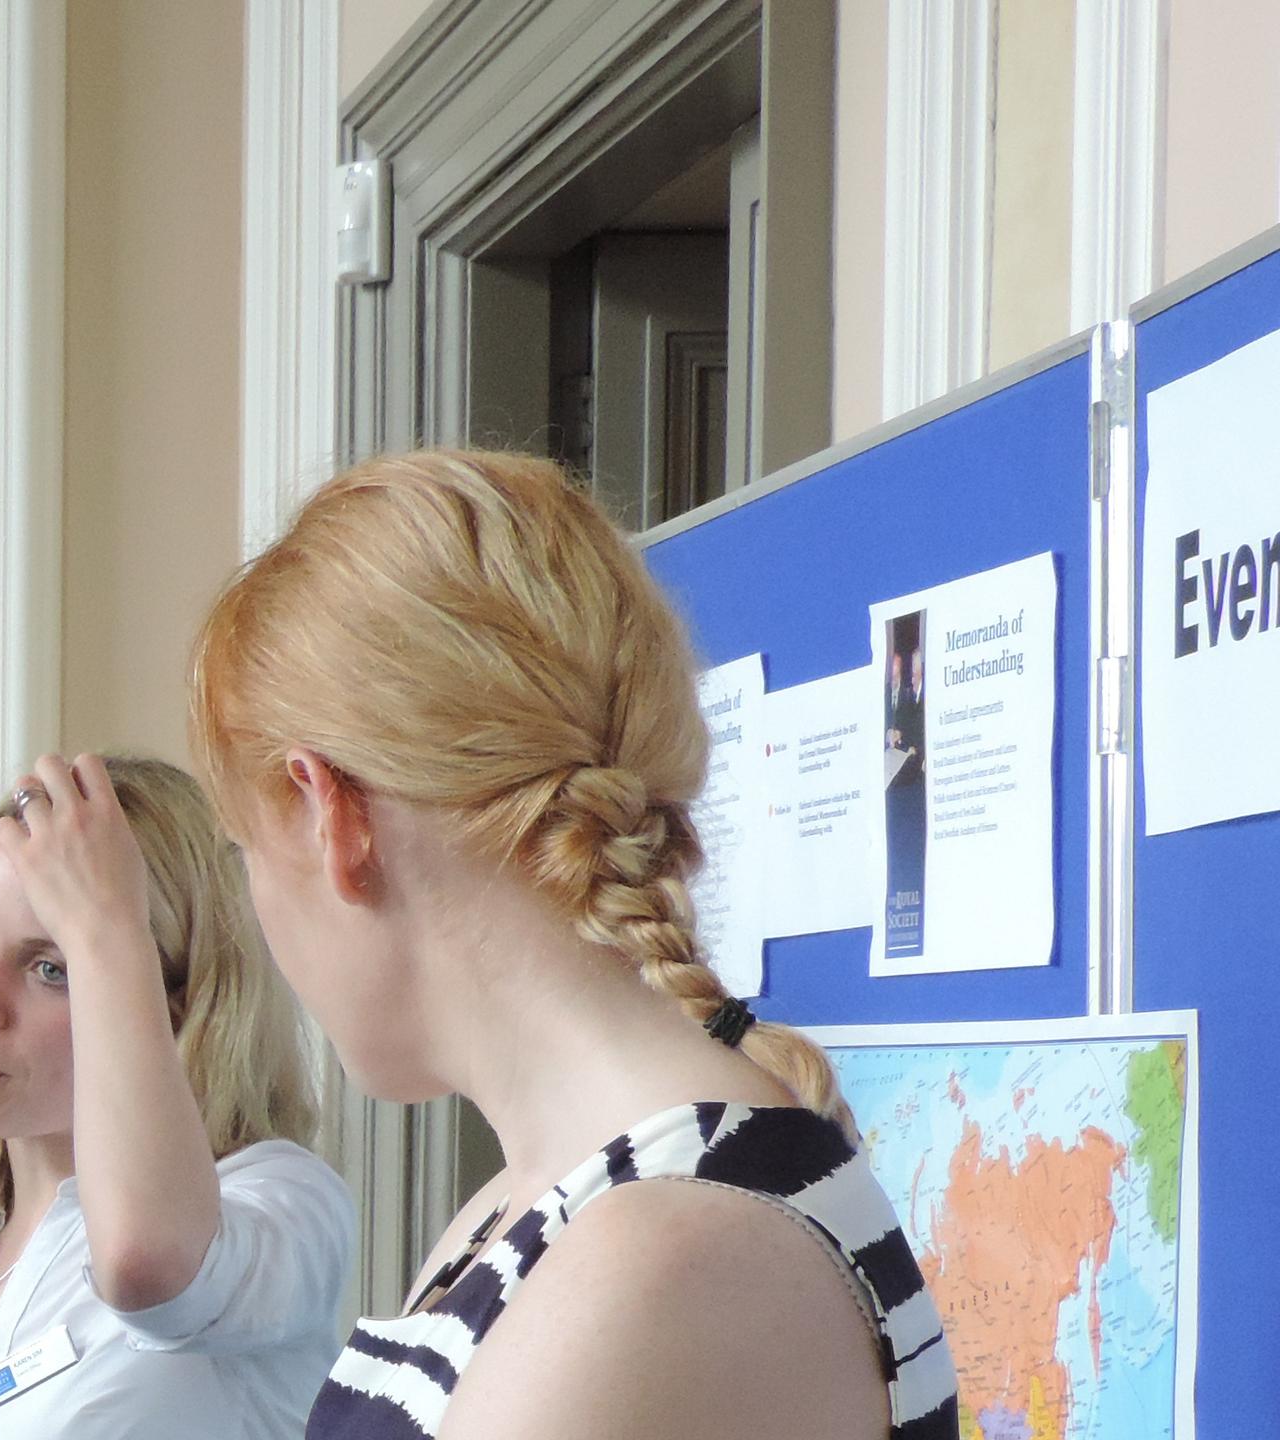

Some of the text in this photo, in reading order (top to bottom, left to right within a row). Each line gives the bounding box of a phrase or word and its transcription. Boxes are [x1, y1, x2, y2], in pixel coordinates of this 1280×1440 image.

[945, 609, 1024, 653] Memoranda of
[943, 649, 1025, 688] Understanding
[888, 910, 920, 929] SOCIETY
[950, 1281, 1010, 1313] RUSSIA
